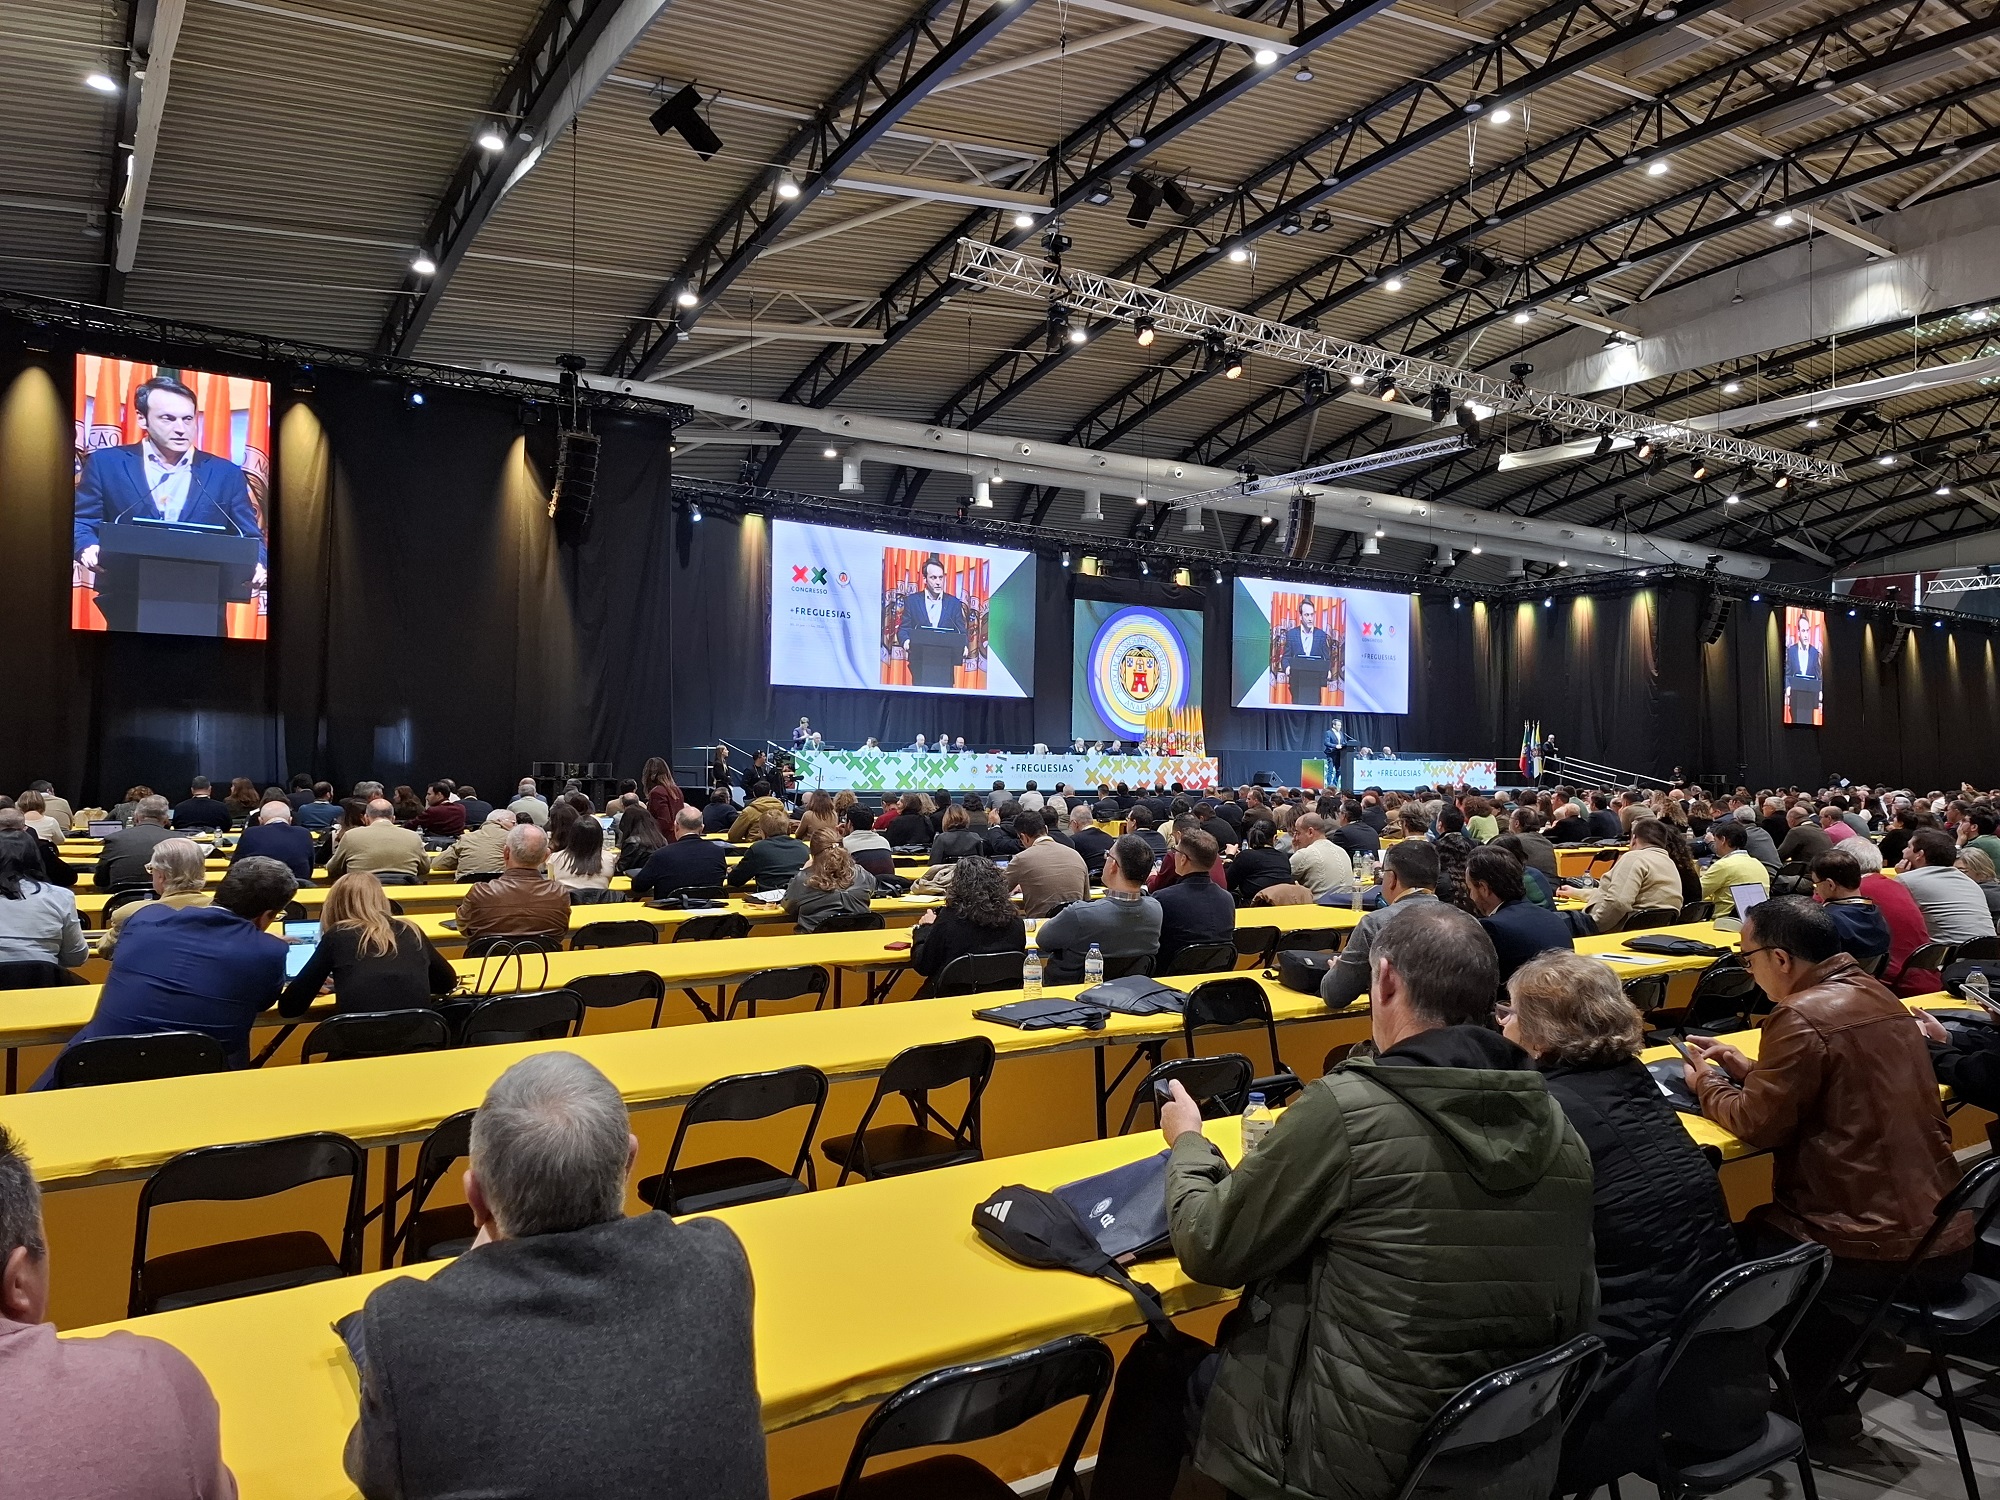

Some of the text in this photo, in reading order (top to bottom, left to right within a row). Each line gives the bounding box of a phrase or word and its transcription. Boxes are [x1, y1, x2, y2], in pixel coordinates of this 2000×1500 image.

[791, 586, 828, 595] CONGRESSO
[790, 606, 851, 619] +FREGUESIAS
[1011, 763, 1074, 773] +FREGUESIAS
